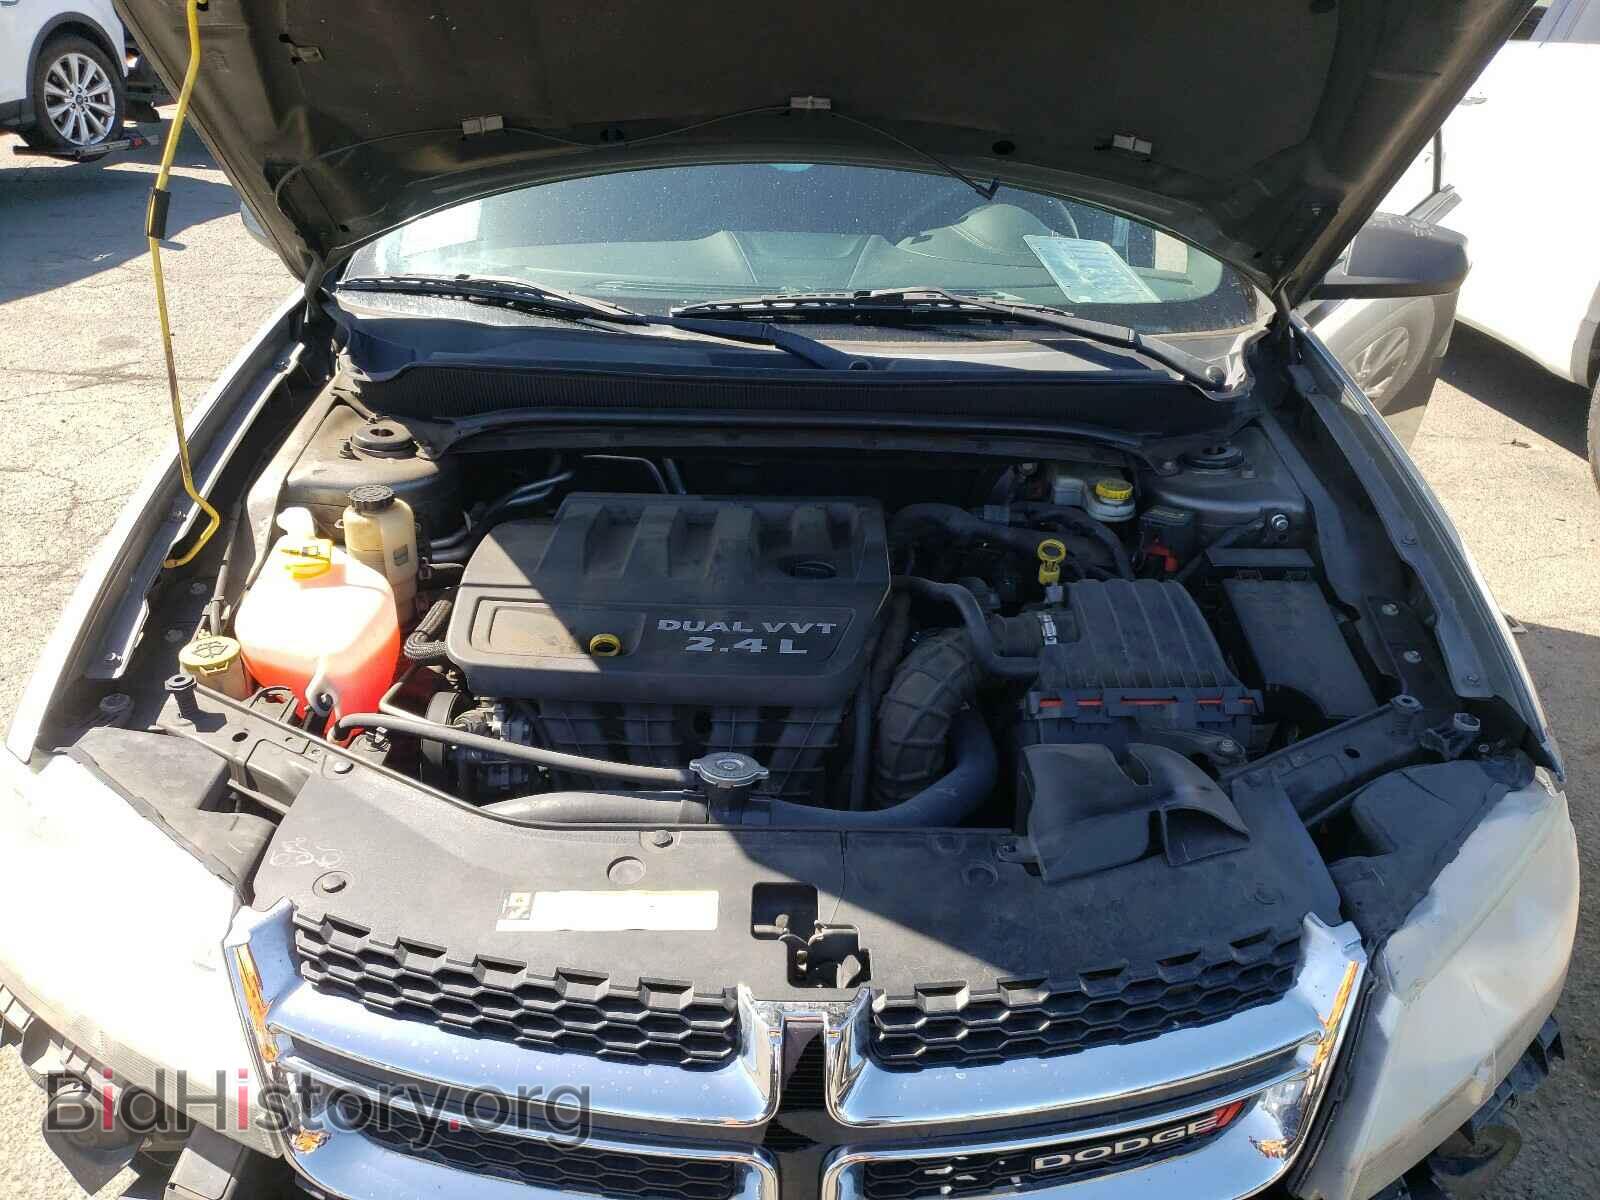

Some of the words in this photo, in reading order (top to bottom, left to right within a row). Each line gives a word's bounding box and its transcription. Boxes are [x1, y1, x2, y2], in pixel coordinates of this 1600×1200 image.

[657, 619, 754, 633] DUAL
[762, 622, 837, 634] VVT
[685, 636, 768, 653] 2.4
[779, 639, 808, 654] L
[1034, 1115, 1217, 1170] DODGE
